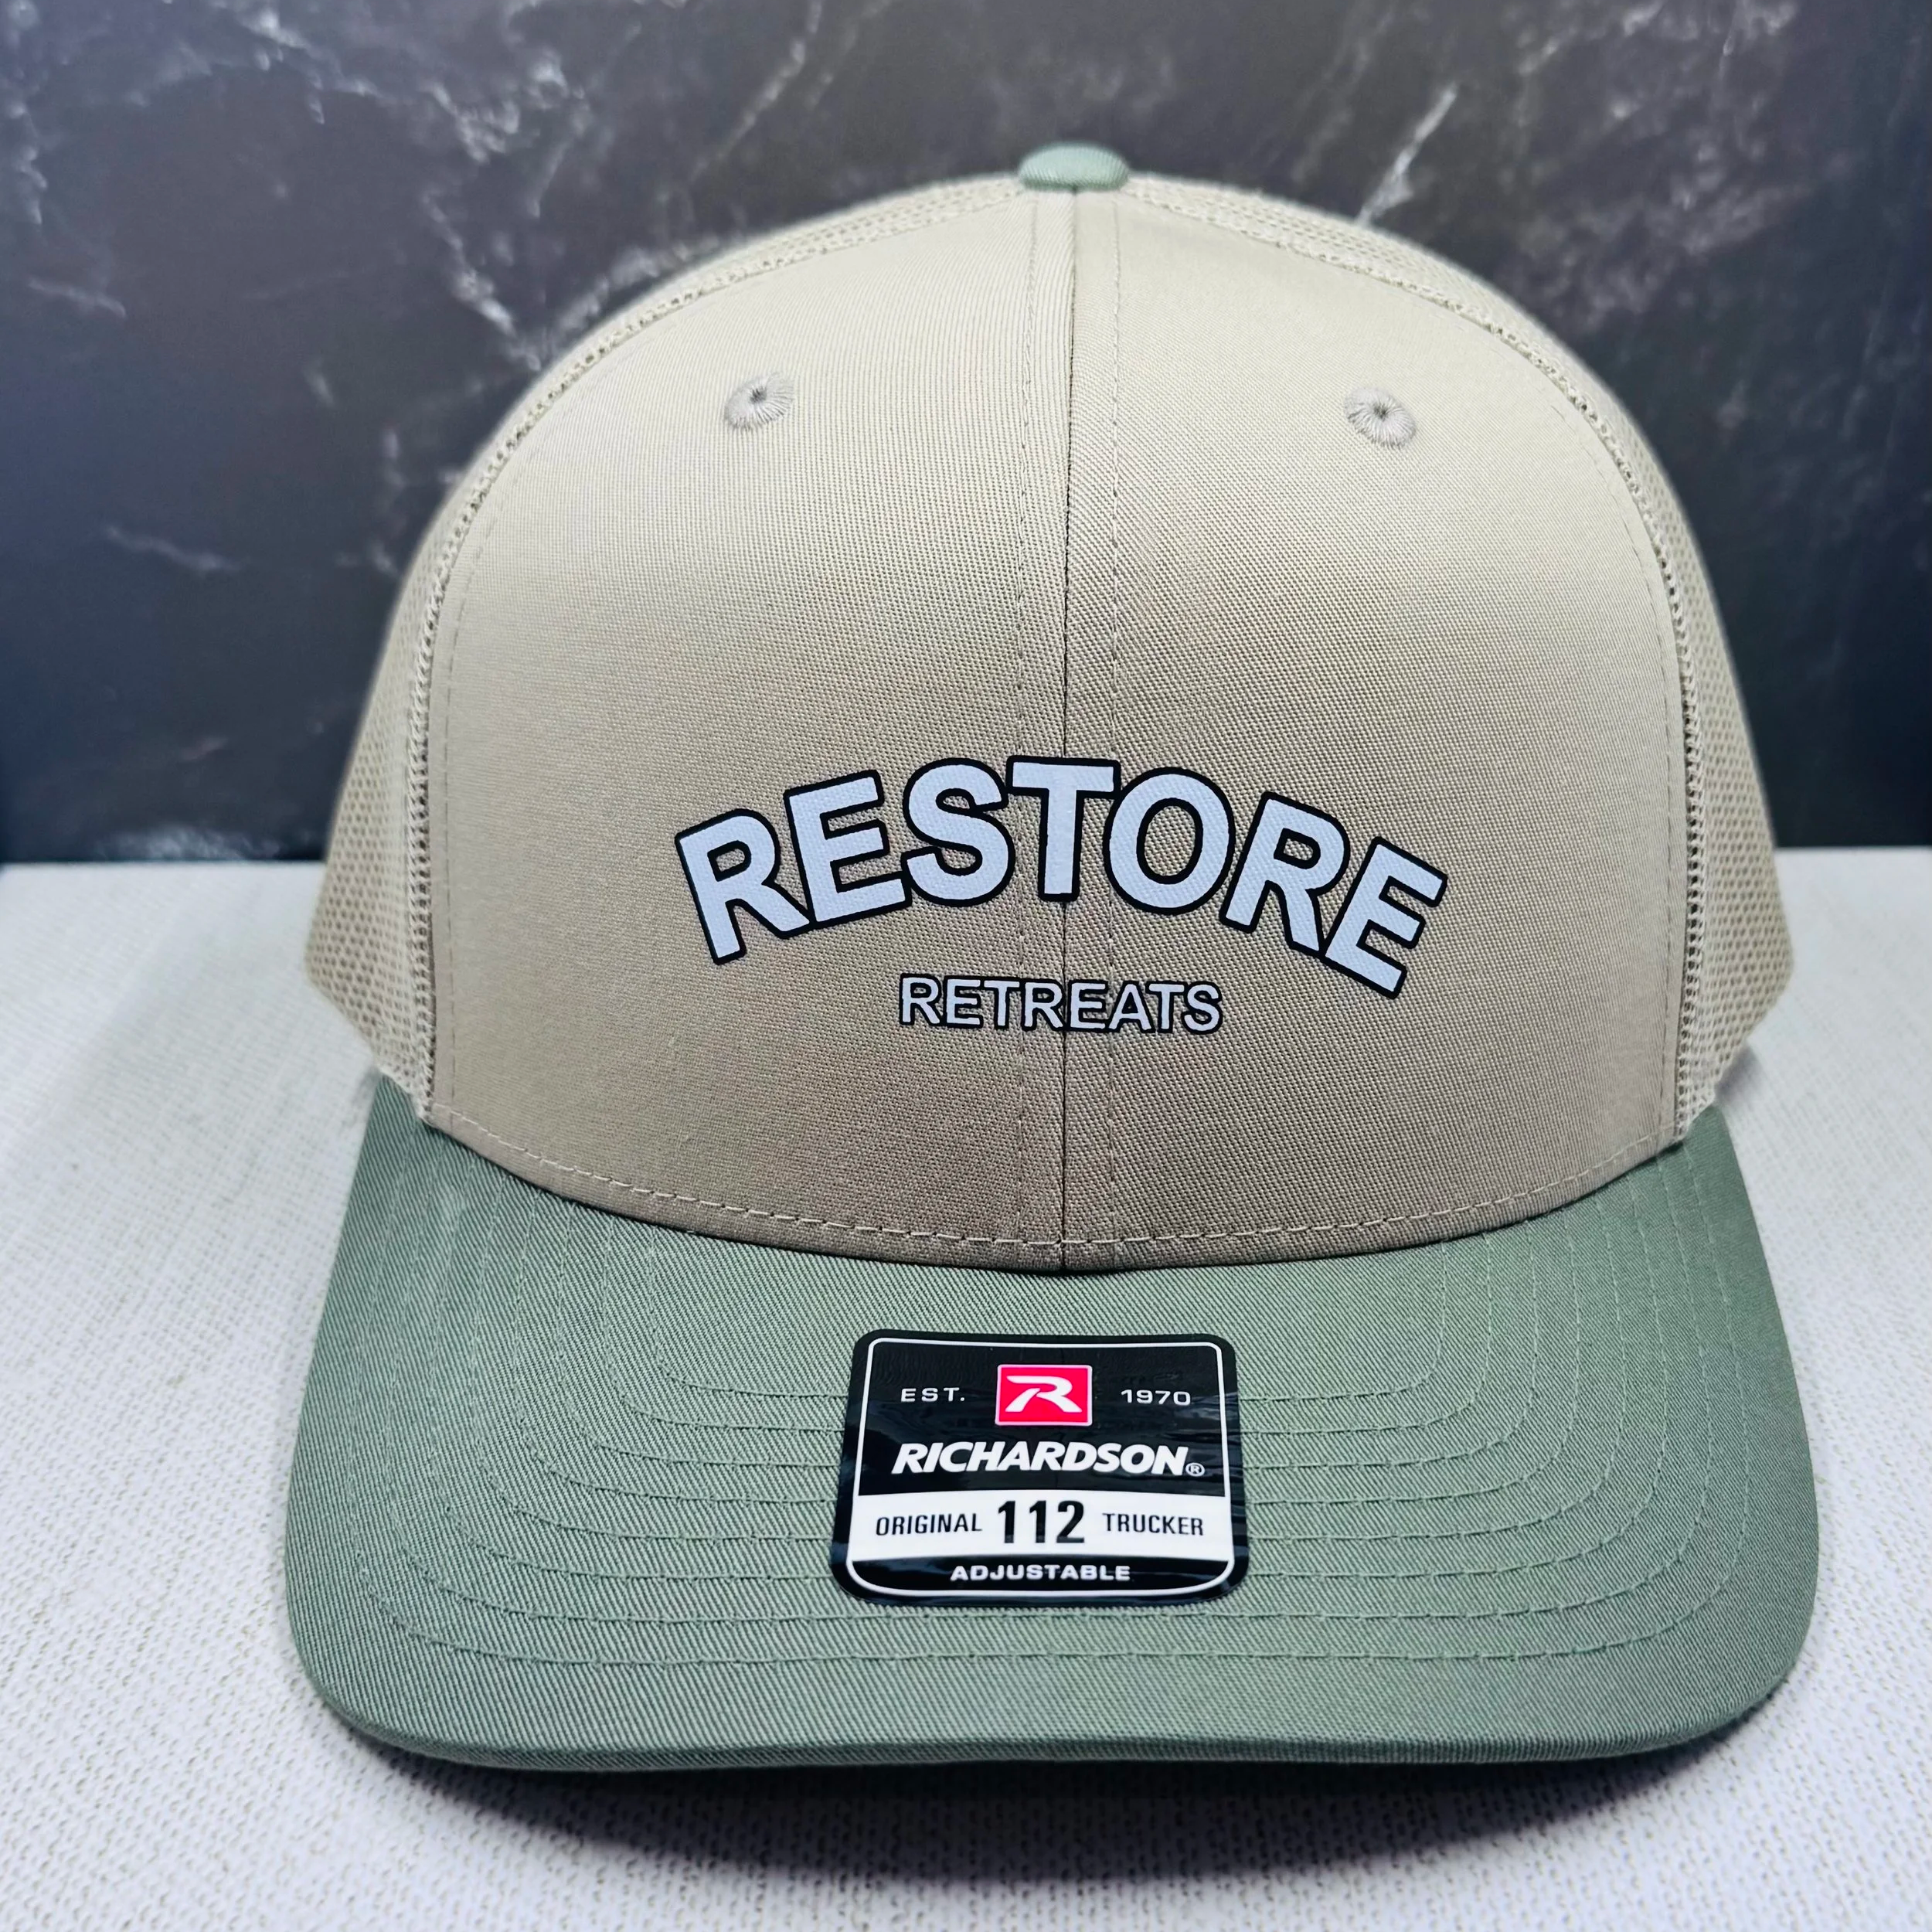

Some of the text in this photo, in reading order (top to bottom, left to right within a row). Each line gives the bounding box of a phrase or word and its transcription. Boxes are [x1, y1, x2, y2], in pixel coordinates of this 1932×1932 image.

[675, 754, 1447, 998] RESTORE
[899, 973, 1223, 1034] RETREATS
[900, 1388, 965, 1403] EST.
[1121, 1389, 1191, 1406] 1970
[876, 1500, 1204, 1544] ORIGINAL 112 TRUCKER
[950, 1564, 1131, 1582] ADJUSTABLE
